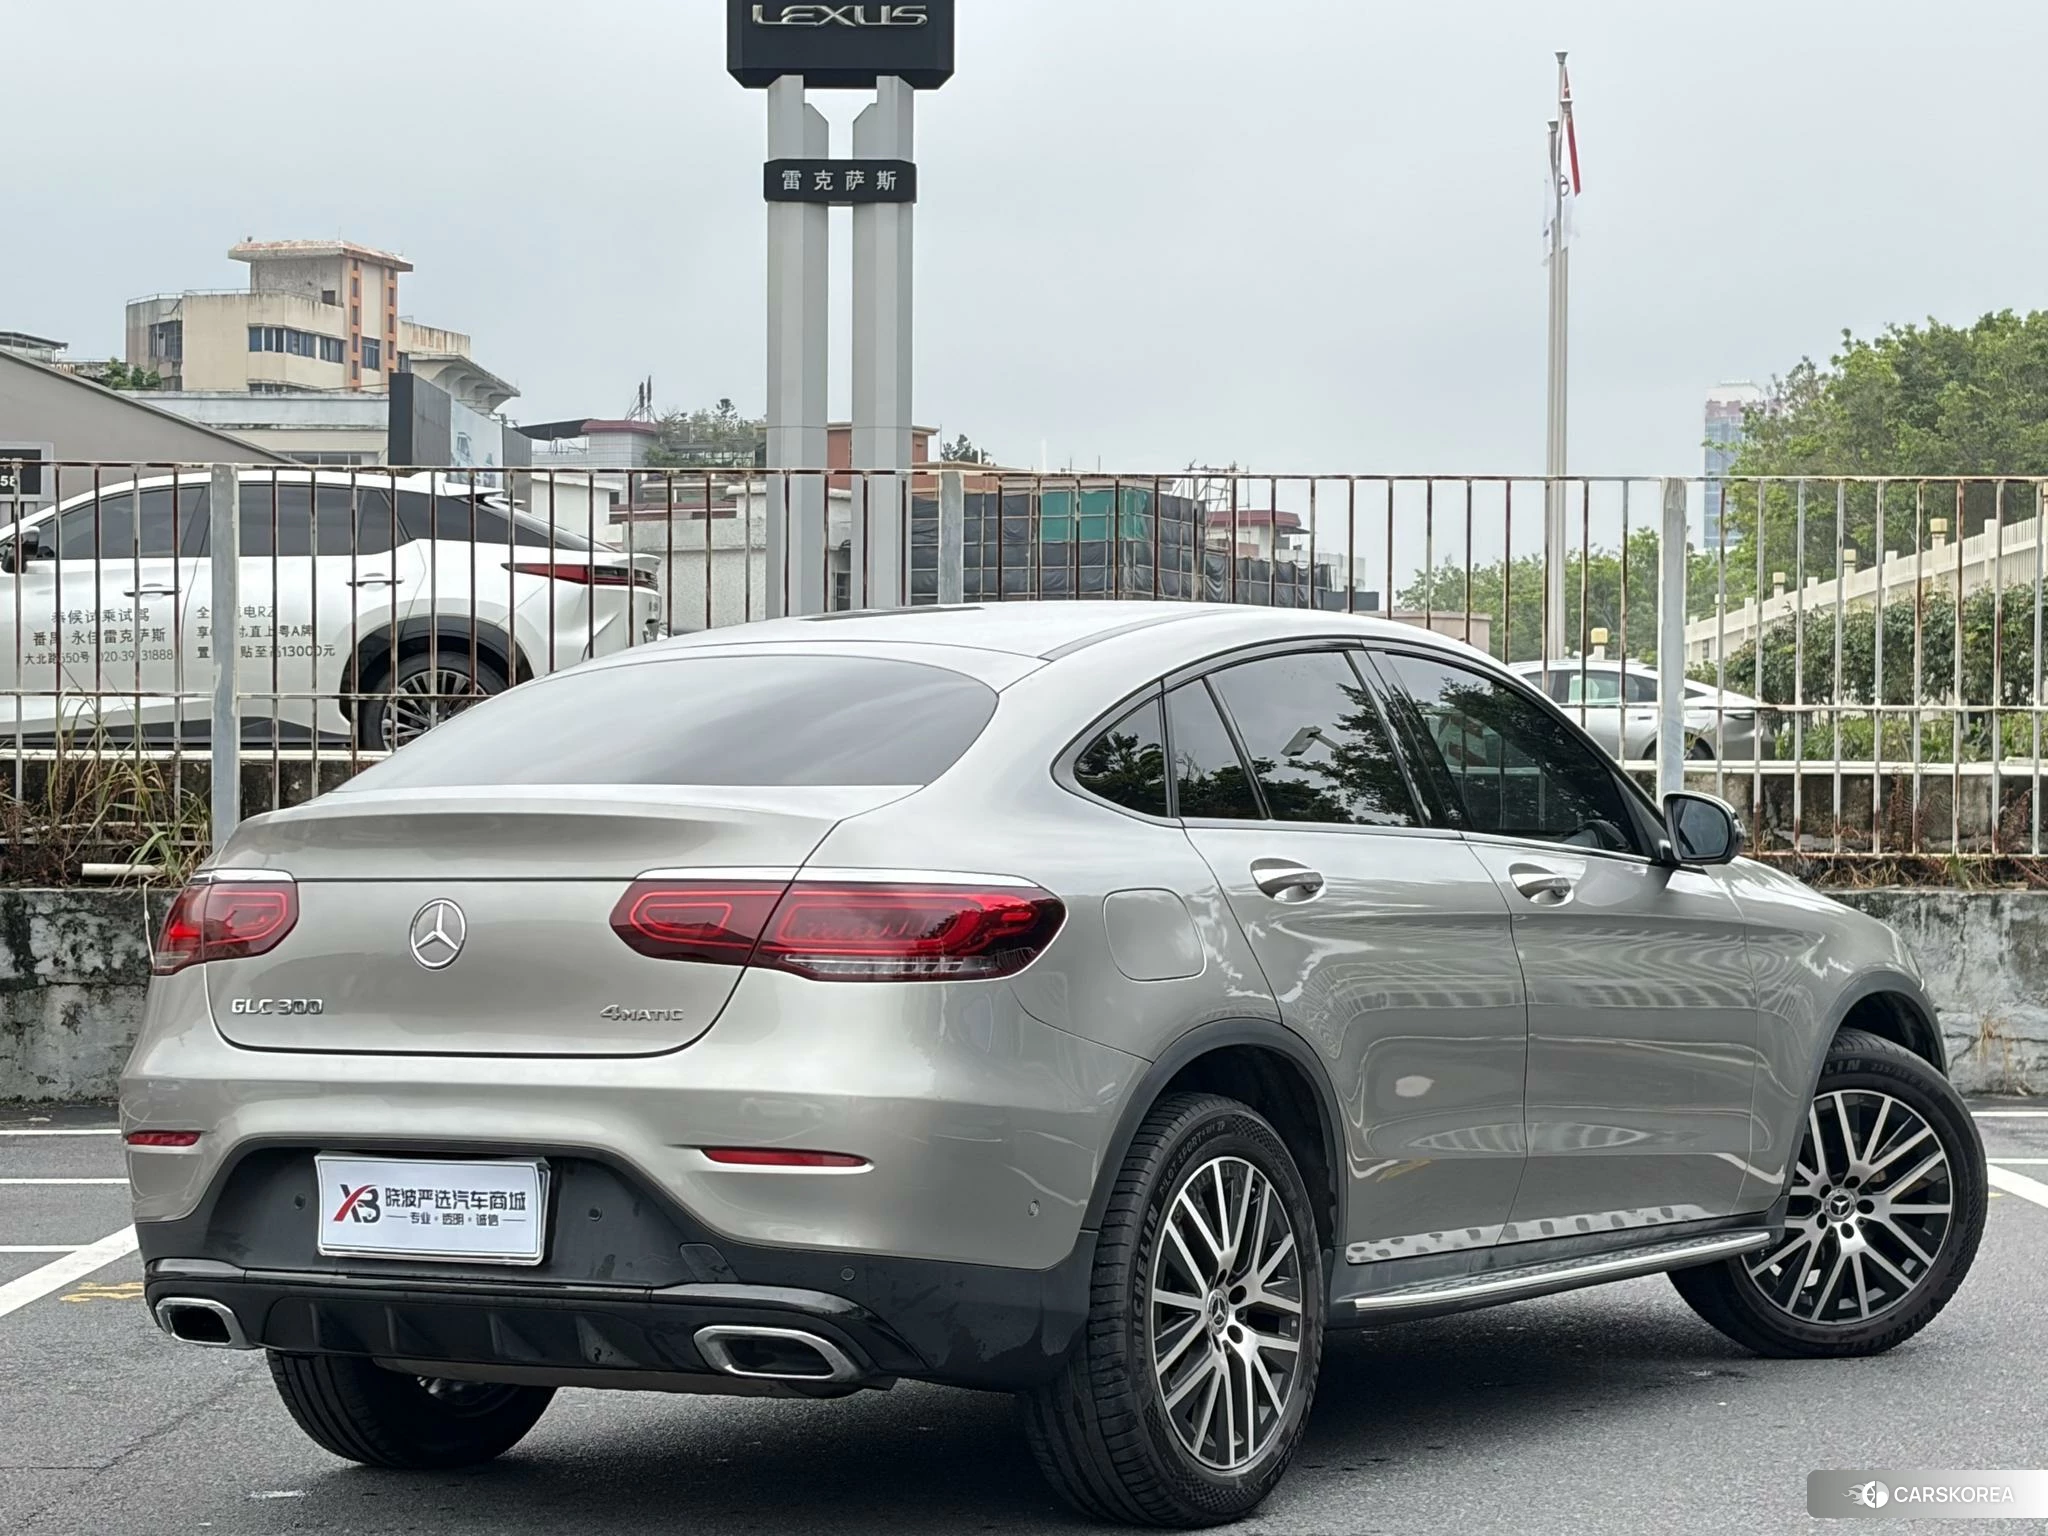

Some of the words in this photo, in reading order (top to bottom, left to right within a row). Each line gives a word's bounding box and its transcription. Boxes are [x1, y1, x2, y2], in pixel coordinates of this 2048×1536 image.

[752, 4, 928, 27] LEXUS
[781, 169, 897, 191] 雷克萨斯
[231, 998, 274, 1015] GLC
[277, 998, 324, 1015] 300
[600, 1004, 684, 1021] 4MATIC
[385, 1187, 527, 1211] 晓波严选汽车商城
[1133, 1203, 1160, 1351] MICHELIN
